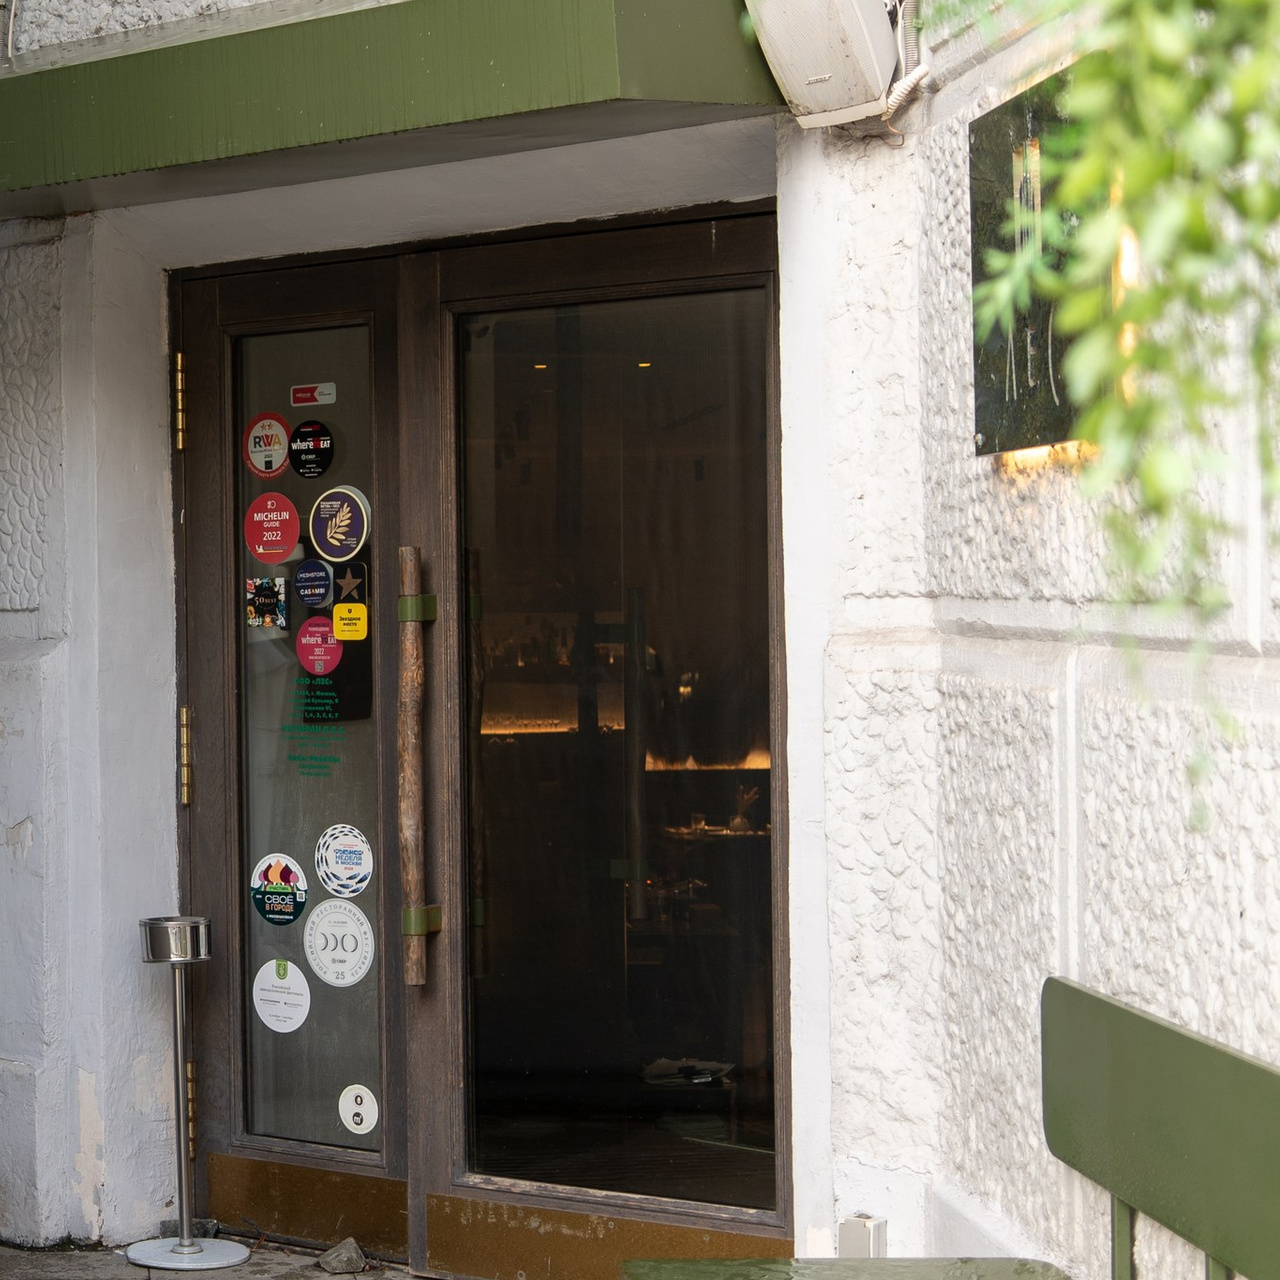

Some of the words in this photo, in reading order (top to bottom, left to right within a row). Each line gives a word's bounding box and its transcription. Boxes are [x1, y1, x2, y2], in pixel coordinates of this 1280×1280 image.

[253, 433, 282, 448] RWA
[253, 511, 290, 521] MICHELIN
[263, 531, 281, 541] 2022
[254, 596, 265, 606] 50
[265, 903, 270, 911] В
[270, 903, 294, 913] ГОРОДЕ
[316, 904, 364, 927] РЕСТОРАННЫЙ
[307, 920, 327, 975] РОССИЙСКИЙ
[351, 931, 370, 978] ФЕСТИВАЛЬ
